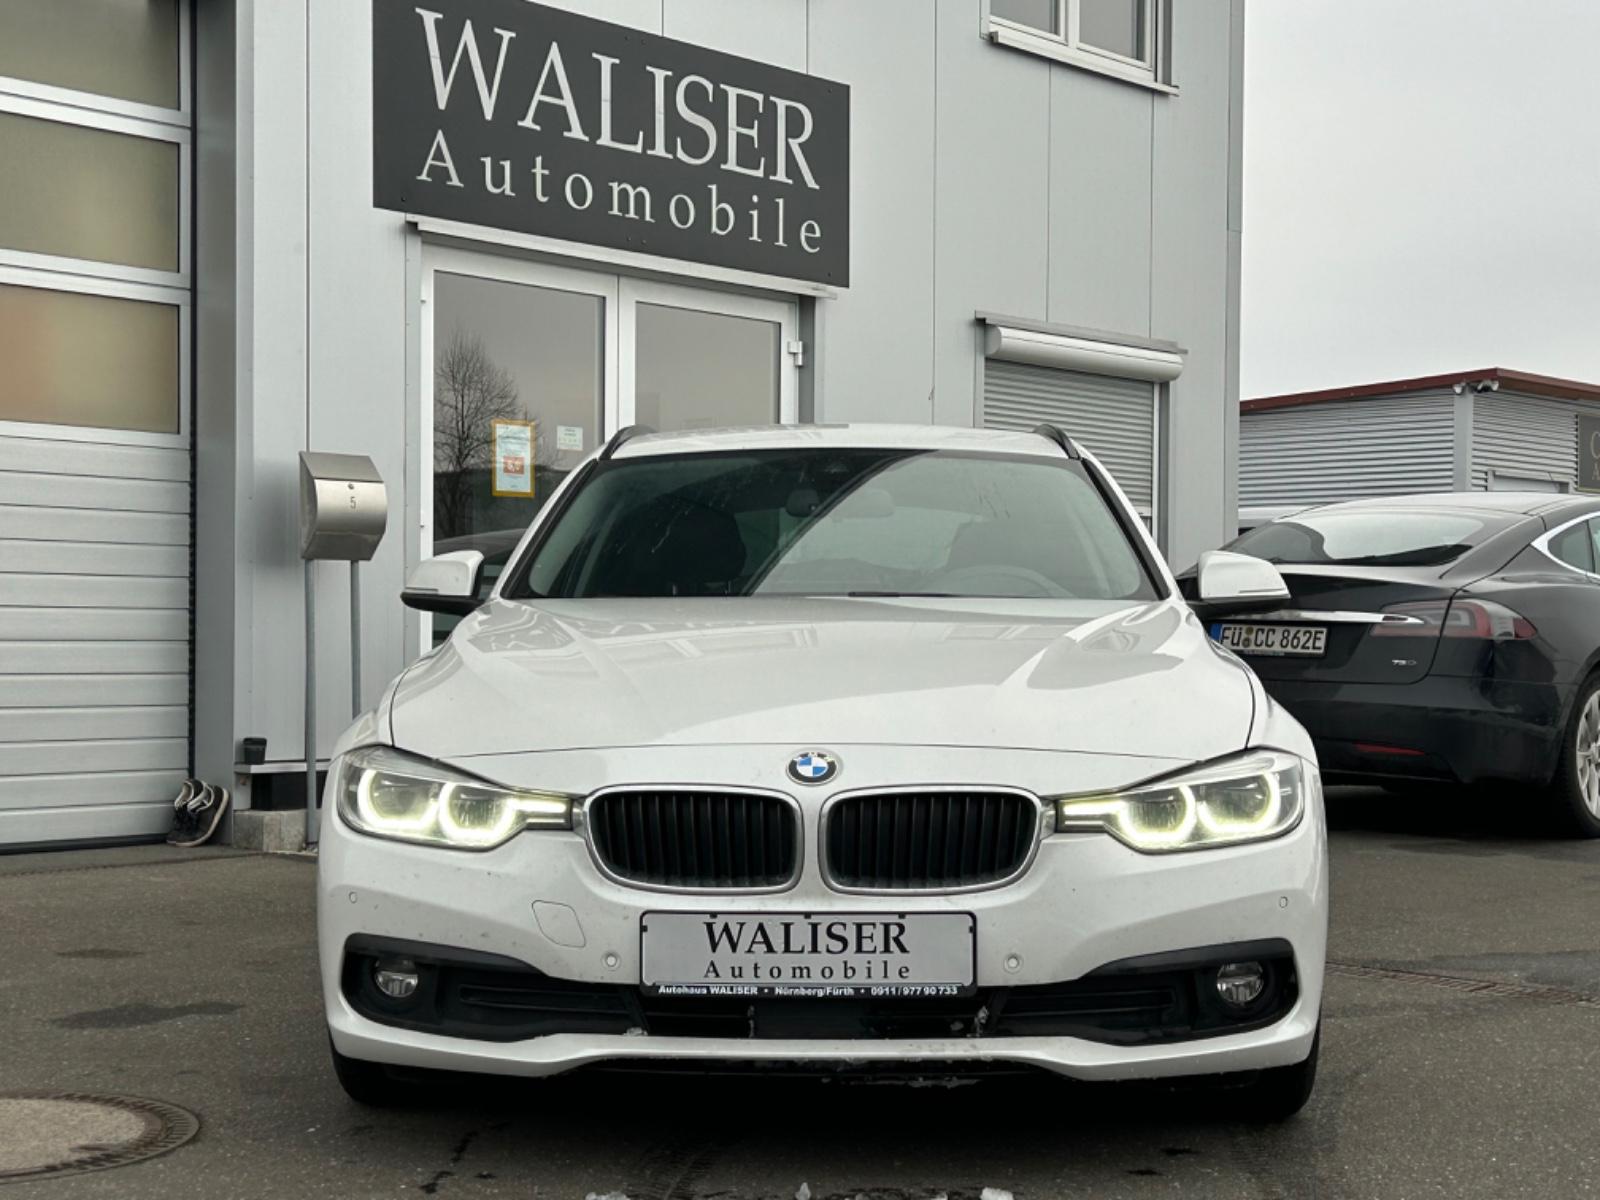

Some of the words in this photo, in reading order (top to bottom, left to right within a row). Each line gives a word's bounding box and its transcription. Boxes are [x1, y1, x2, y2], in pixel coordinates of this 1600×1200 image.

[415, 8, 819, 190] WALISER
[416, 130, 822, 253] Automobile
[350, 496, 356, 509] 5
[1221, 627, 1242, 647] FÜ
[1254, 628, 1276, 648] CC
[1280, 629, 1324, 650] 862E
[703, 921, 910, 954] WALISER
[704, 960, 910, 979] Automobile
[658, 985, 707, 995] Autohaus
[709, 985, 758, 996] WALISER
